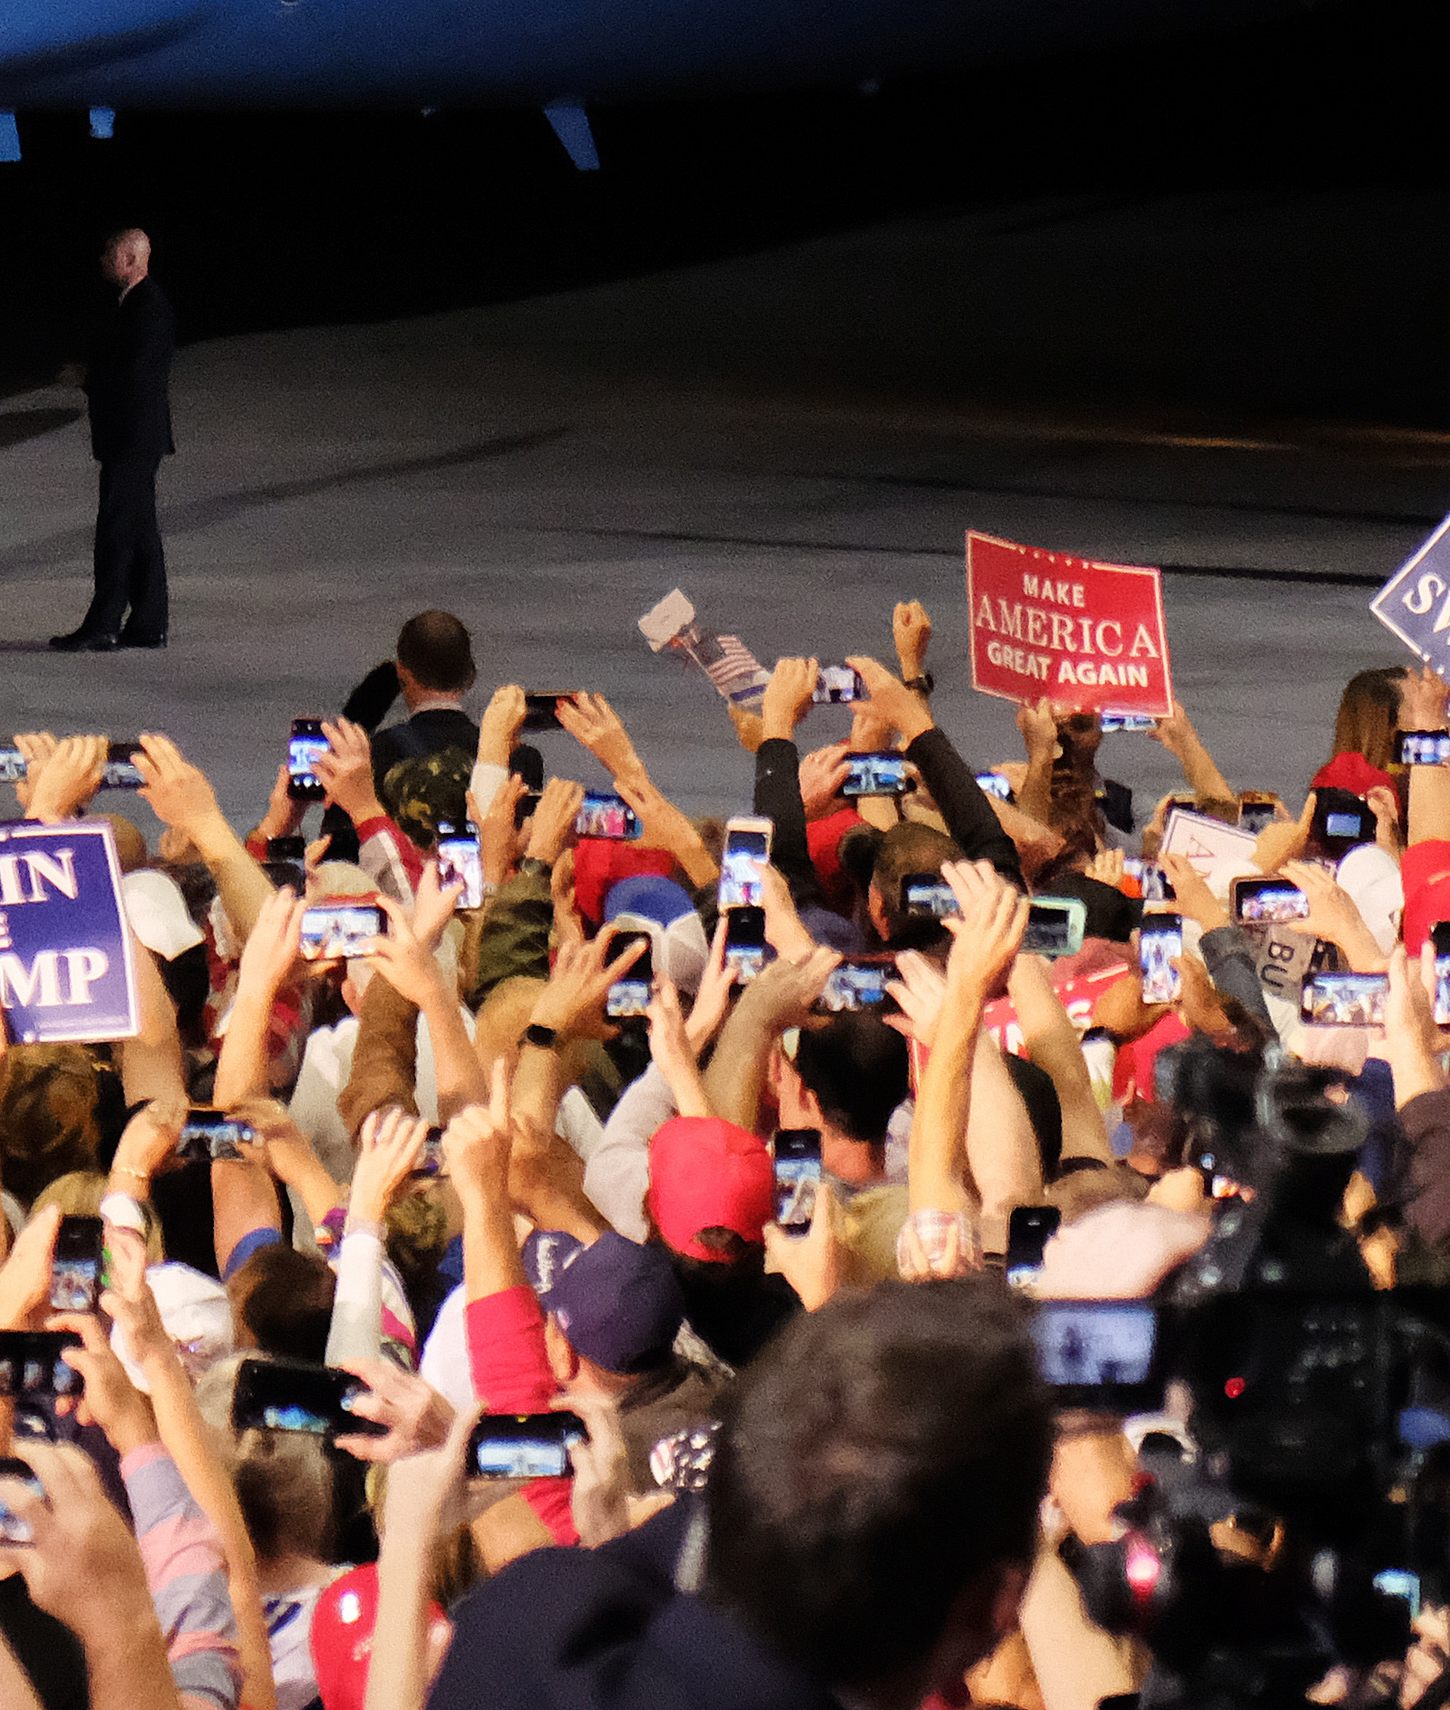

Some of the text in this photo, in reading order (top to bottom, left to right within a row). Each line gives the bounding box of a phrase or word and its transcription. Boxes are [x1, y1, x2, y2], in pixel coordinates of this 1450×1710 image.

[1022, 573, 1087, 608] MAKE
[975, 593, 1161, 659] AMERICA
[986, 640, 1149, 688] GREAT AGAIN
